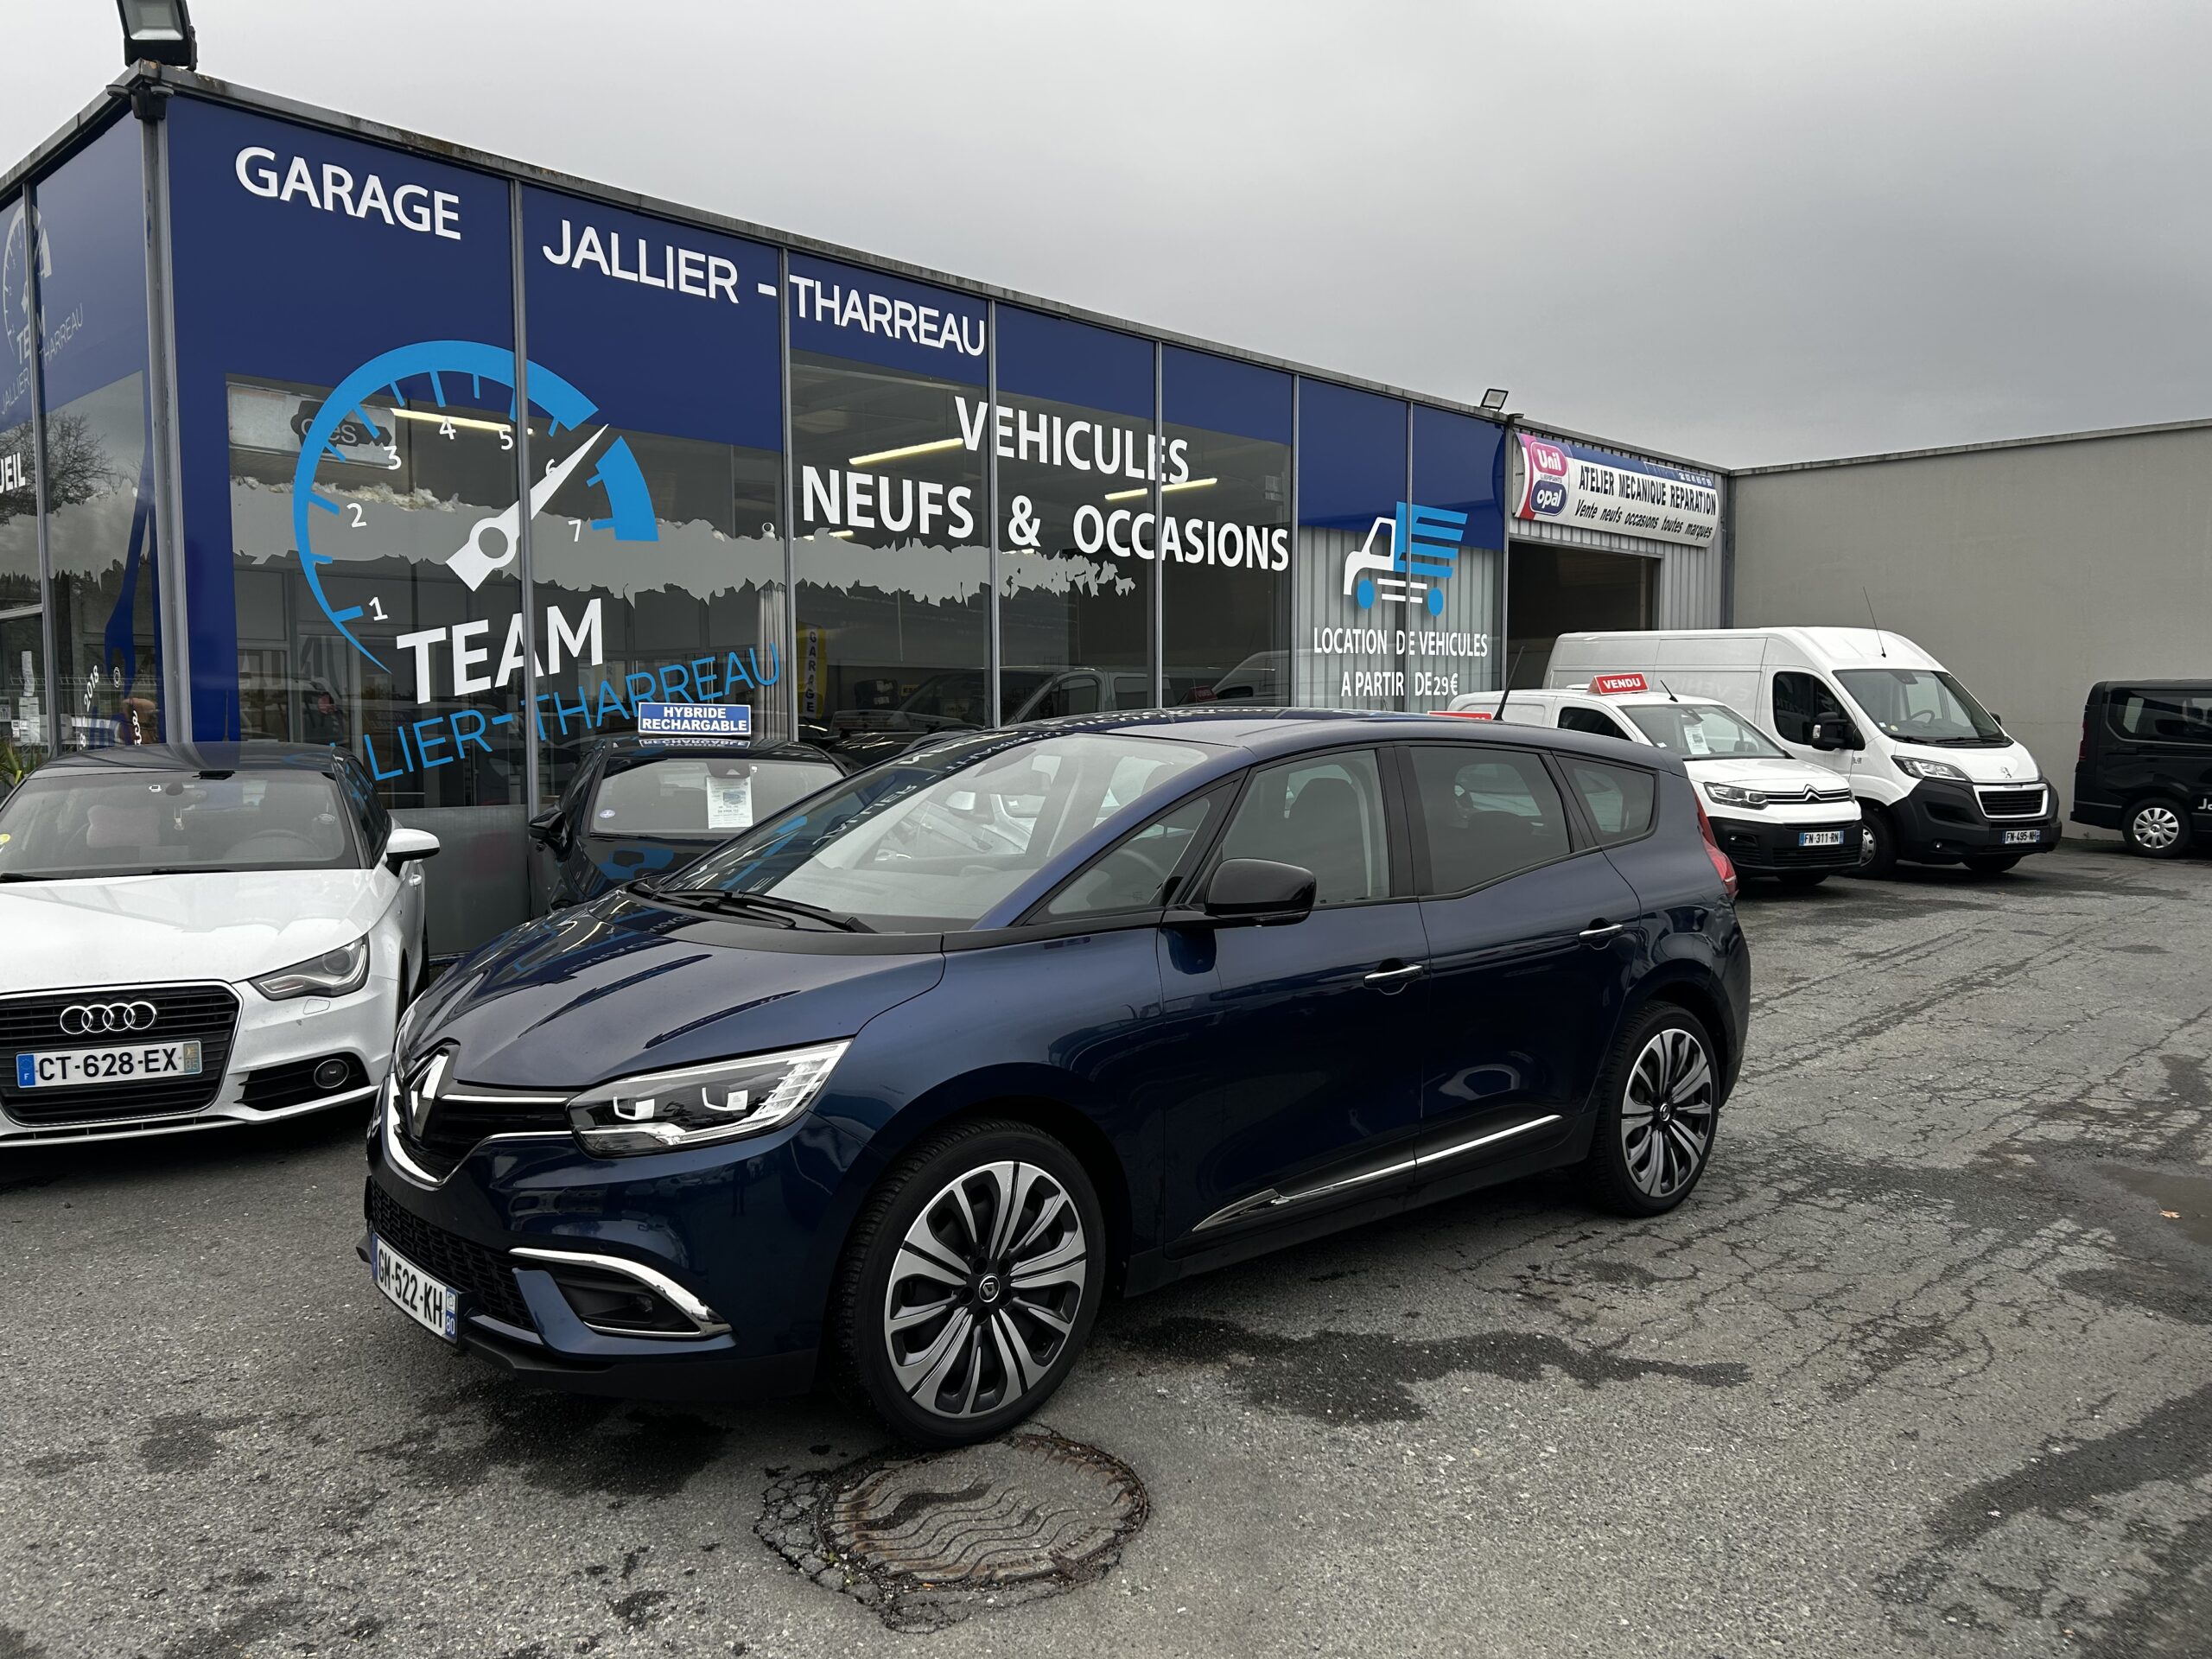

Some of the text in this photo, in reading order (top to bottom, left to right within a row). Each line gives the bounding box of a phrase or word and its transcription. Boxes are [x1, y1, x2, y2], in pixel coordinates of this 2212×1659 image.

[235, 146, 461, 240] GARAGE
[543, 219, 739, 303] JALLIER
[789, 274, 985, 356] THARREAU
[16, 305, 46, 365] TEM
[439, 416, 456, 440] 4
[499, 426, 513, 450] 5
[955, 396, 1190, 484] VEHICULES
[383, 445, 402, 470] 3
[1537, 448, 1561, 471] Unil
[1536, 489, 1562, 509] opal
[1579, 465, 1614, 496] ATELIER
[1618, 474, 1666, 506] MECANIQUE
[1670, 485, 1716, 516] REPARATION
[346, 503, 367, 528] 2
[802, 465, 1289, 571] NEUFS & OCCASIONS
[1574, 499, 1713, 541] Vente neufs occasions toutes marques
[568, 520, 582, 542] 7
[368, 597, 388, 621] 1
[396, 598, 603, 704] TEAM
[1313, 627, 1387, 655] LOCATION
[1419, 631, 1488, 657] VEHICULES
[84, 664, 99, 712] 2018
[1341, 671, 1351, 696] A
[1355, 671, 1404, 696] PARTIR
[1602, 677, 1642, 690] VENDU
[642, 718, 747, 731] RECHARGABLE
[664, 706, 727, 719] HYBRIDE
[38, 1047, 178, 1081] CT-628-EX
[378, 1249, 442, 1328] GM-522-KH
